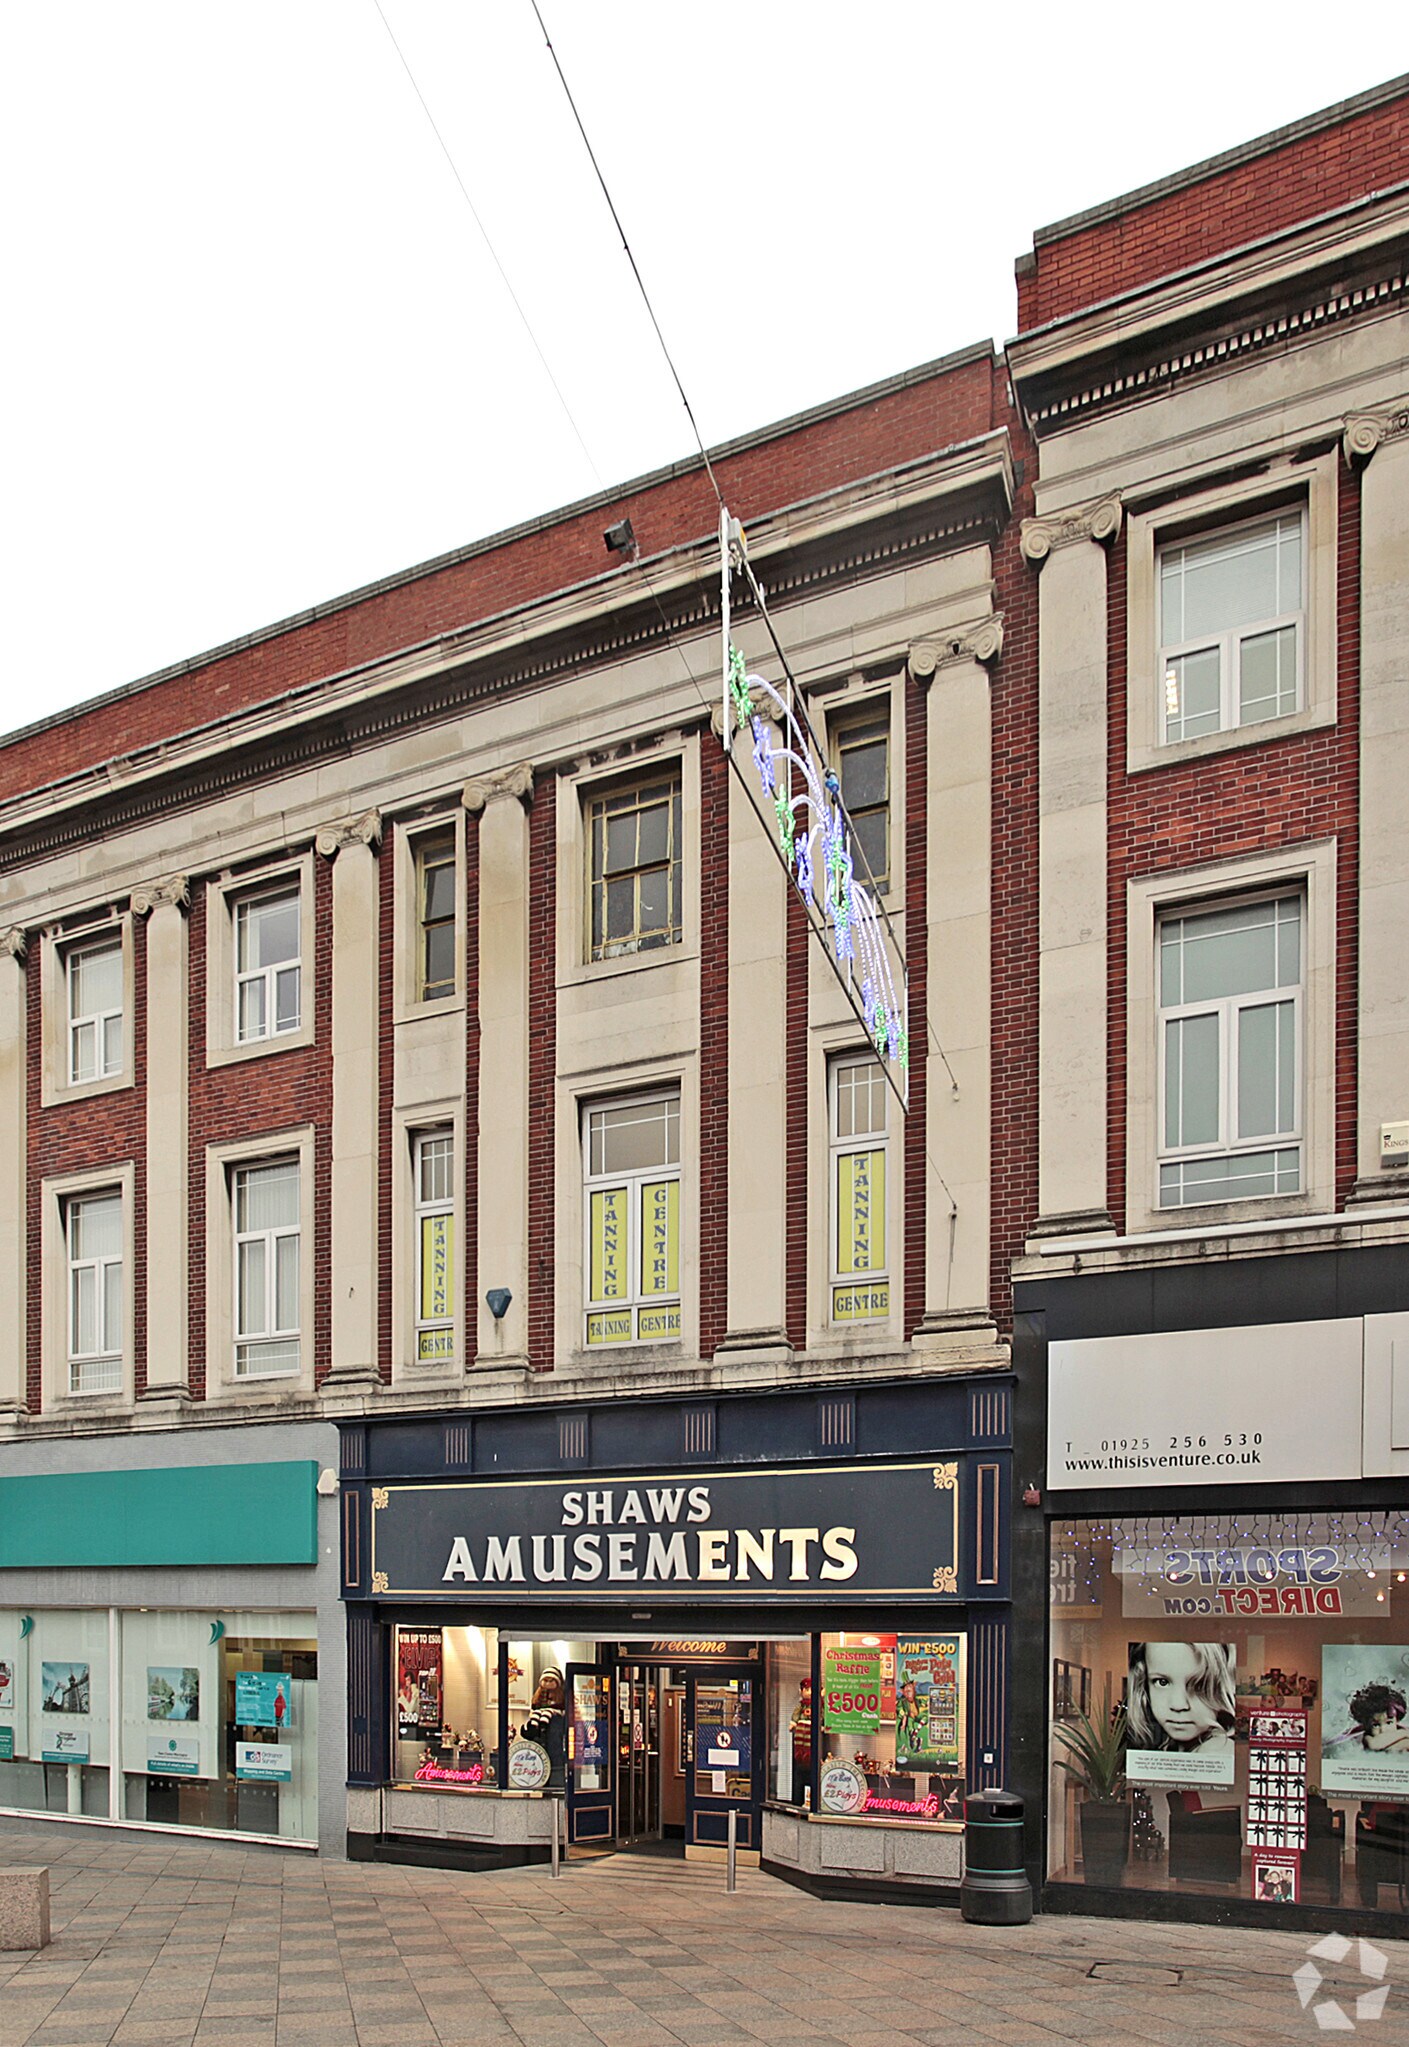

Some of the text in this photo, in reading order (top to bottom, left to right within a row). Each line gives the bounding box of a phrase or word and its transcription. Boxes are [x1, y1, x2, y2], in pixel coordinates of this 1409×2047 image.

[854, 1158, 869, 1268] TANNING
[604, 1194, 618, 1296] TANNING
[434, 1221, 445, 1314] TANNING
[1101, 1438, 1150, 1452] 01925
[1170, 1436, 1206, 1448] 256
[1224, 1433, 1262, 1446] 530
[1065, 1450, 1261, 1470] www.thisisventure.co.uk
[561, 1486, 712, 1525] SHAWS
[442, 1526, 859, 1582] AMUSEMENTS
[410, 1634, 418, 1643] UP
[419, 1634, 427, 1644] TO
[650, 1641, 727, 1653] Welcome
[898, 1642, 956, 1655] WIN £500
[826, 1650, 880, 1660] Christmas
[836, 1663, 870, 1675] Raffle
[827, 1692, 878, 1714] £500
[400, 1712, 418, 1723] £500
[415, 1762, 482, 1781] Amusements
